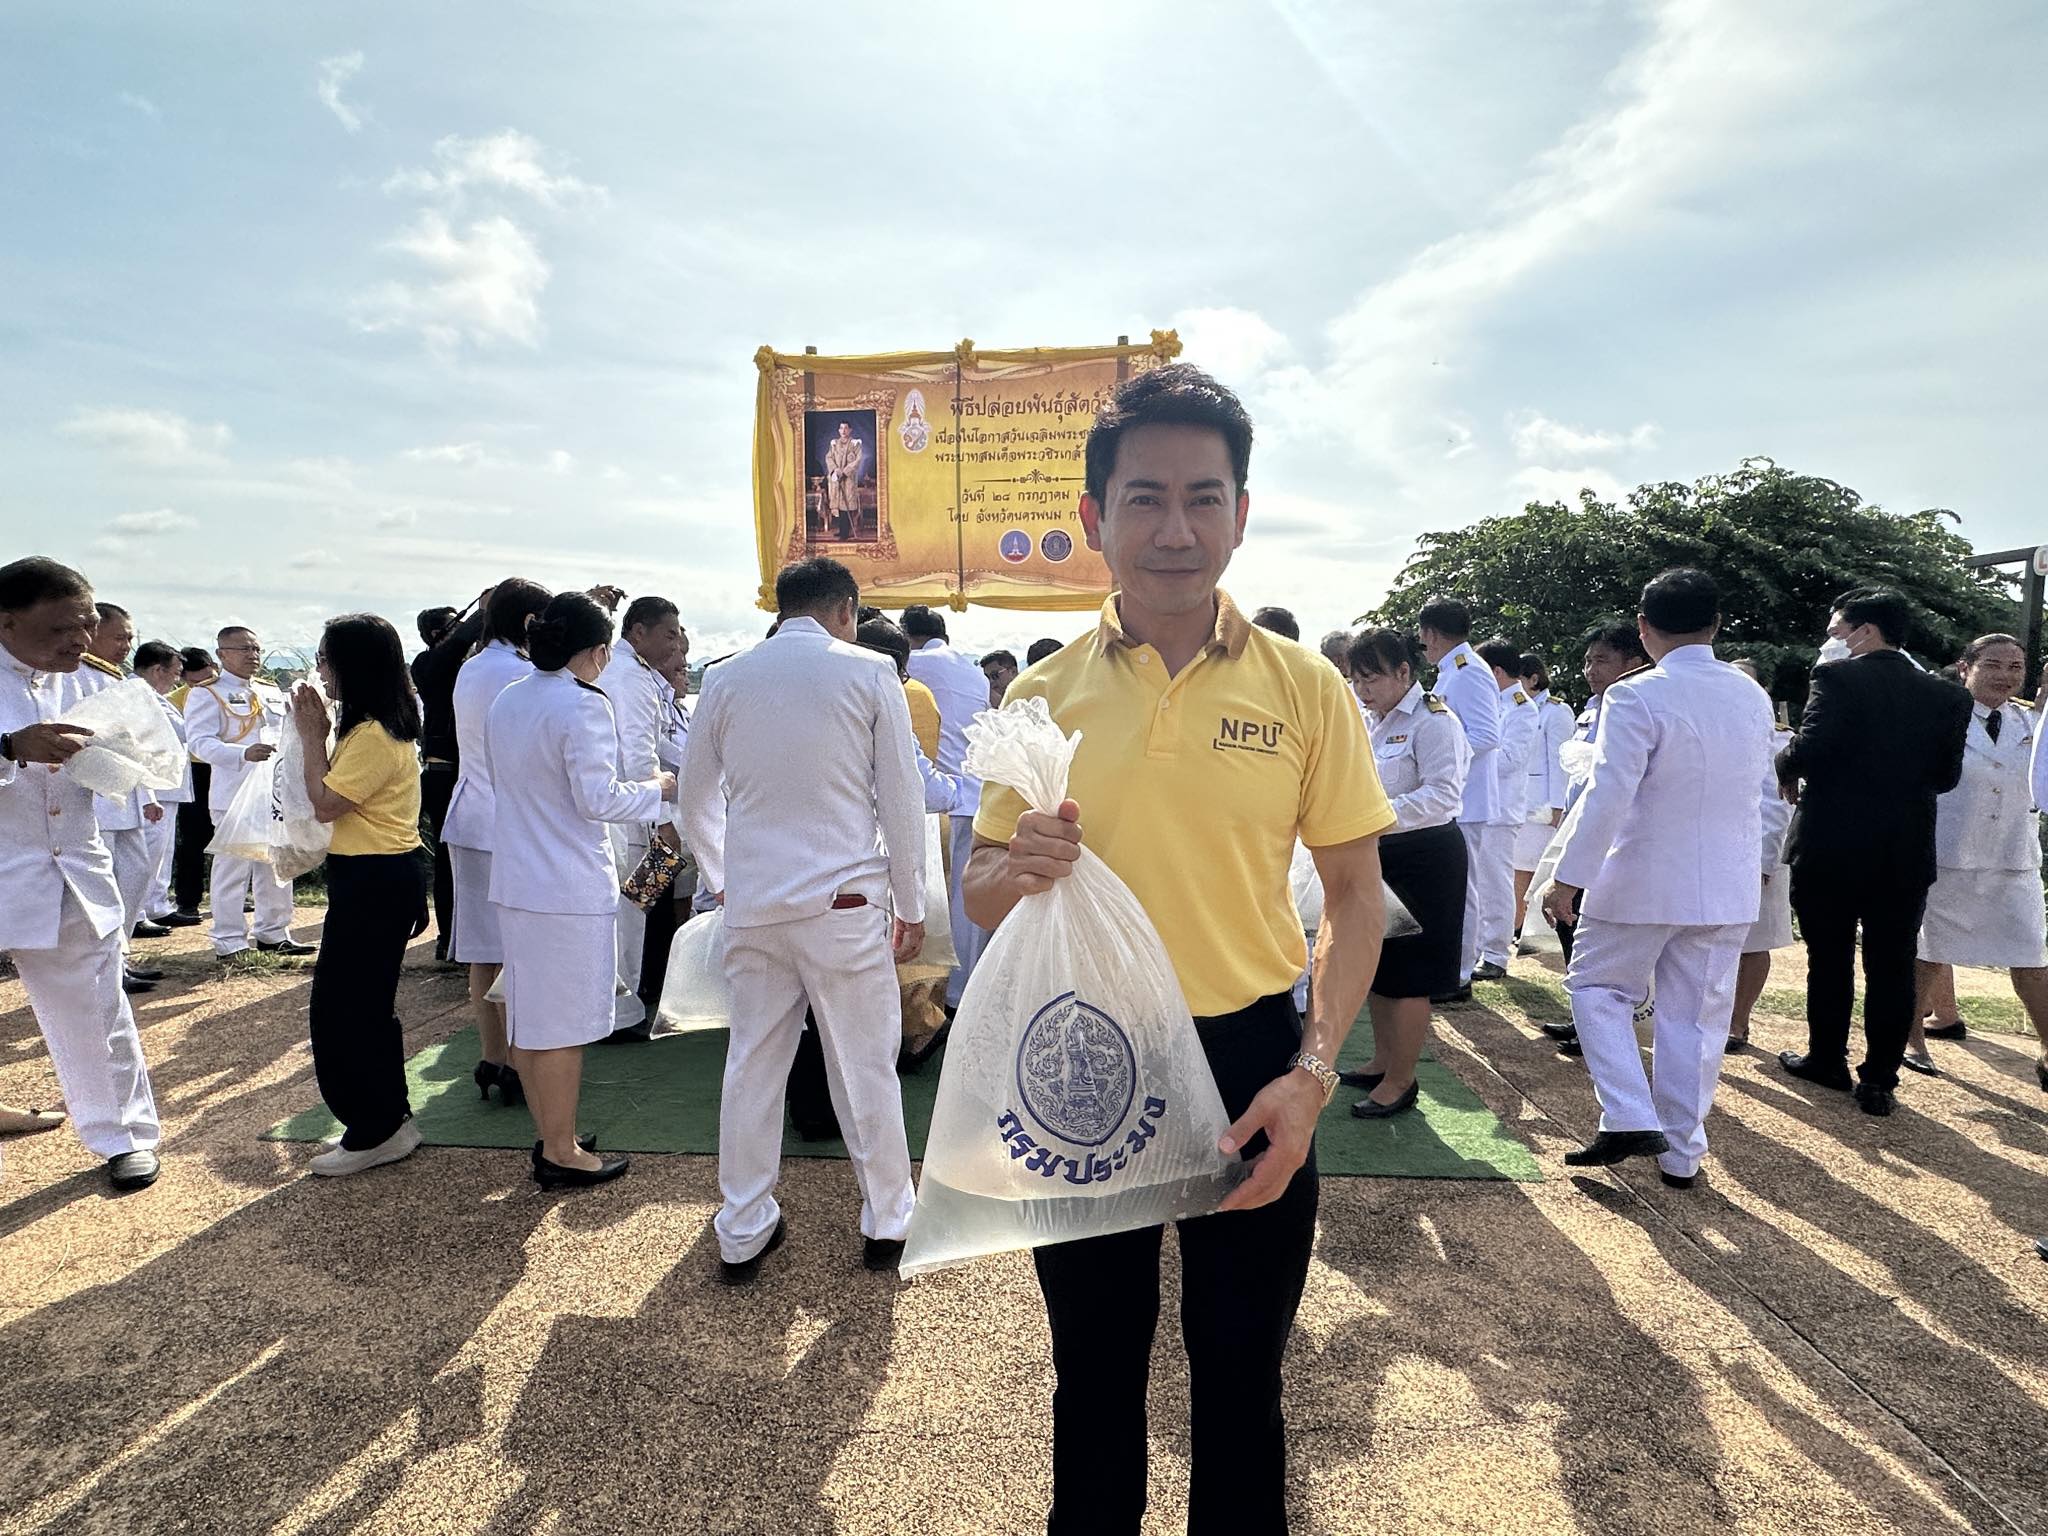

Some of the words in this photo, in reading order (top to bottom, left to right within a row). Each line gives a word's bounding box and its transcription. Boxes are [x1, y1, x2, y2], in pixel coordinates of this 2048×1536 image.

[935, 426, 1088, 445] เนื่องในโอกาสวันเฉลิมพระช
[935, 443, 1086, 463] พระบาทสมเด็จพระวชิรเกล้
[962, 485, 985, 504] วันที่
[992, 491, 1010, 502] ๒๘
[1018, 489, 1070, 504] กรกฎาคม
[946, 507, 969, 524] โดย
[976, 507, 1062, 524] จังหวัดนครพนม
[1220, 718, 1279, 748] NPU
[997, 1095, 1166, 1185] กรมประมง
